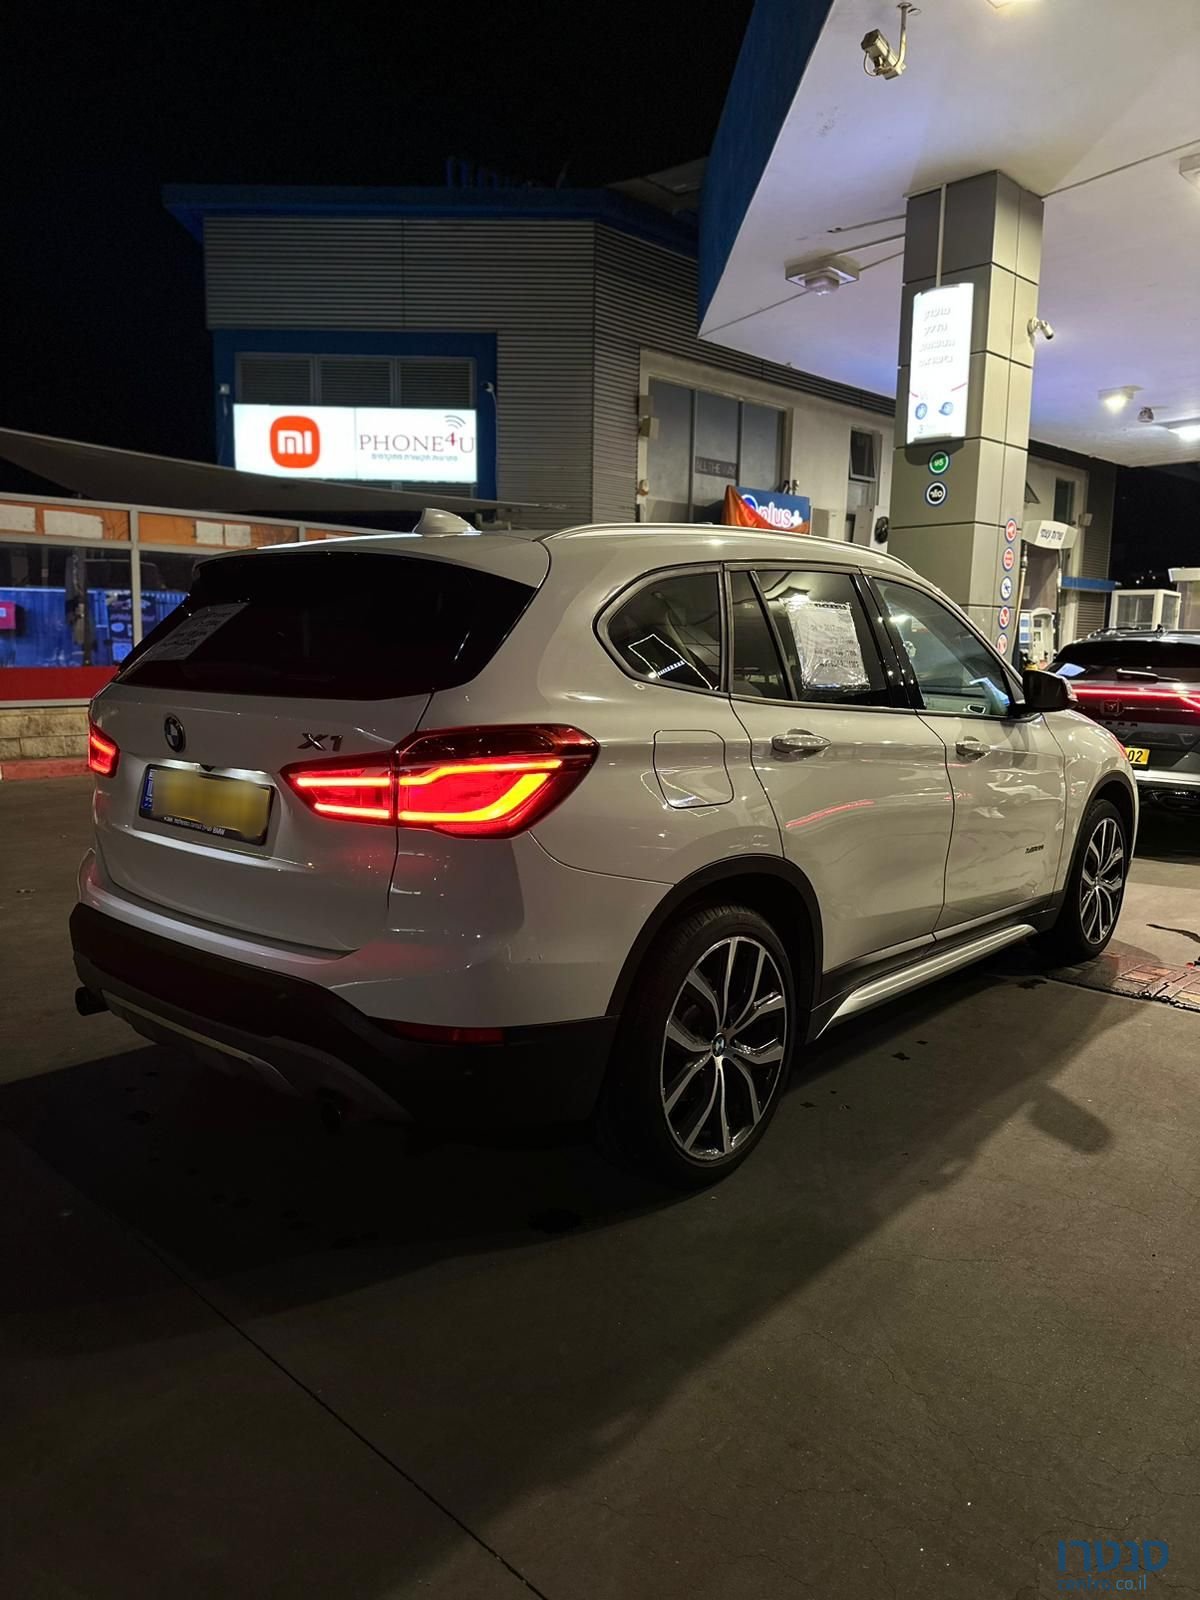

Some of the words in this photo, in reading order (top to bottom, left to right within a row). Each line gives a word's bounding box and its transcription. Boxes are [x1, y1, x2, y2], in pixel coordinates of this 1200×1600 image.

[359, 431, 475, 454] PHONE4U
[297, 731, 344, 752] X1
[1127, 750, 1143, 763] 02
